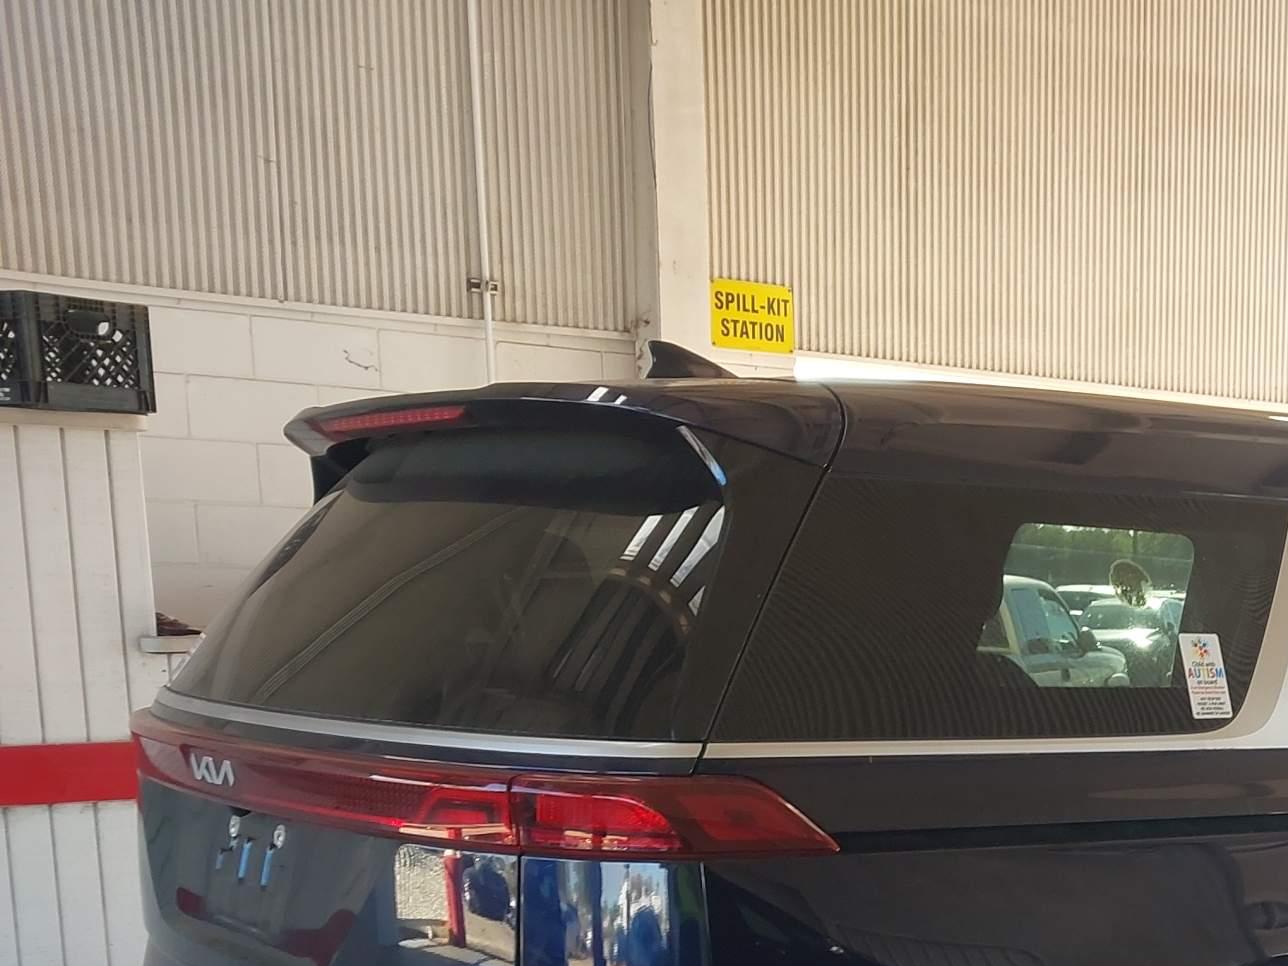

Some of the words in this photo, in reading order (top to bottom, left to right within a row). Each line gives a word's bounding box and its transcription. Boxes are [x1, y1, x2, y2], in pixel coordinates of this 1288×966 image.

[714, 290, 790, 318] SPILL-KIT
[720, 317, 785, 343] STATION
[1188, 667, 1225, 679] AUTISM
[190, 752, 235, 787] KIA
